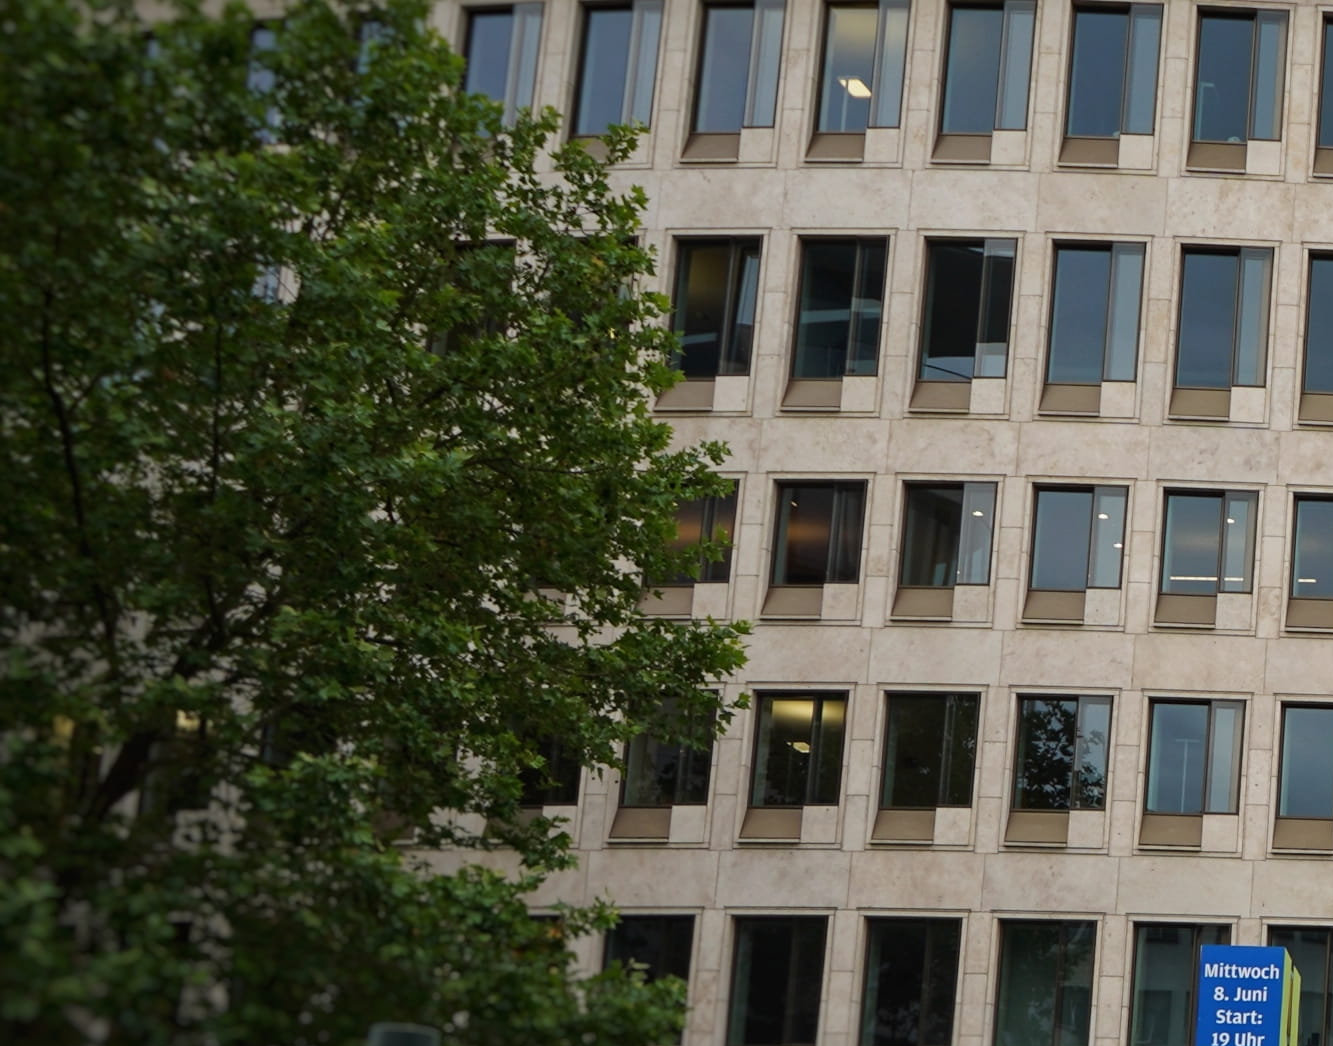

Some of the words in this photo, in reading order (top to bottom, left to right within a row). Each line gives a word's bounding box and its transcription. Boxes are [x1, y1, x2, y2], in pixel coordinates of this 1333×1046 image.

[1204, 963, 1280, 980] Mittwoch
[1213, 986, 1230, 1001] 8.
[1233, 986, 1268, 1002] Juni
[1215, 1009, 1263, 1025] Start:
[1211, 1032, 1230, 1046] 19
